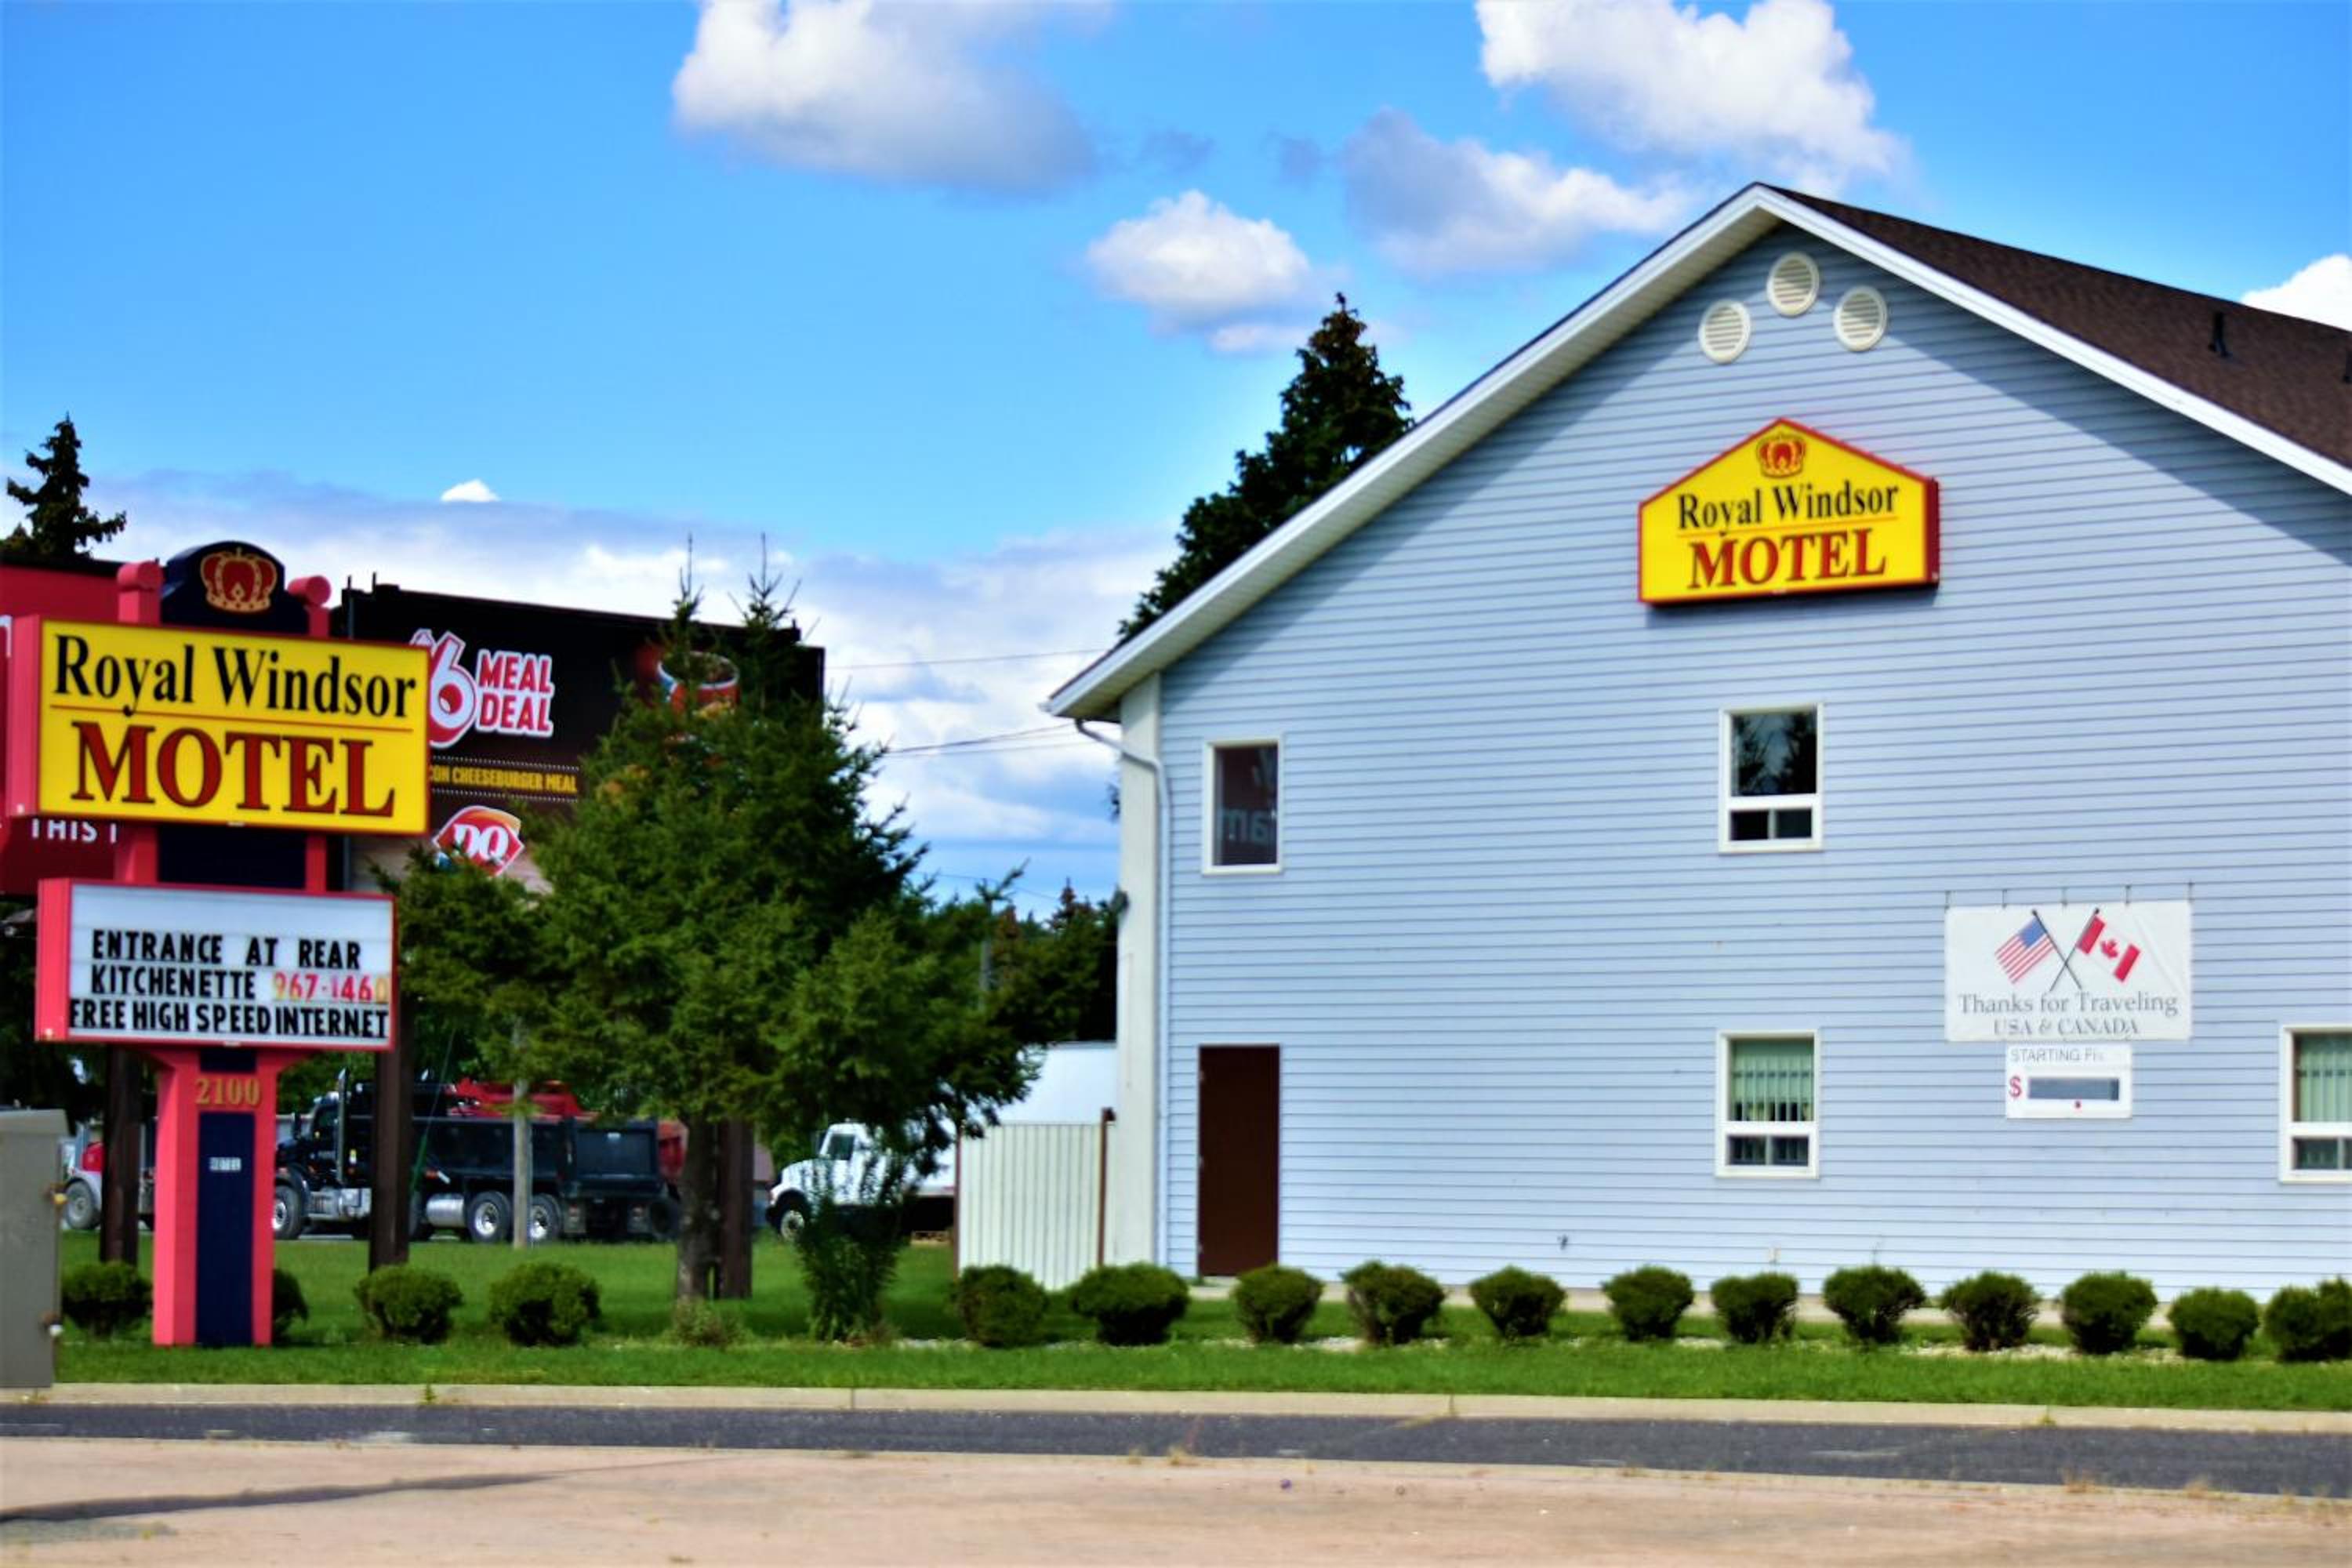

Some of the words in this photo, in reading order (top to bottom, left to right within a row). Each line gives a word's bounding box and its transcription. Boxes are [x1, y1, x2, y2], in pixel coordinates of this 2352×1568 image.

[1678, 488, 1762, 535] Royal
[1772, 479, 1900, 521] Windsor
[1688, 528, 1886, 590] MOTEL
[53, 634, 194, 717] Royal
[212, 647, 416, 718] Windsor
[409, 629, 477, 749] 6
[477, 650, 554, 695] MEAL
[477, 692, 554, 735] DEAL
[70, 720, 395, 818] MOTEL
[429, 764, 450, 784] ON
[452, 766, 543, 792] CHEESEBURGER
[546, 773, 578, 793] MEAL
[452, 823, 510, 862] DQ
[92, 929, 223, 964] ENTRANCE
[245, 938, 279, 967] AT
[299, 938, 361, 970] REAR
[91, 964, 256, 1000] KITCHENETTE
[69, 999, 126, 1029] FREE
[132, 1001, 190, 1033] HIGH
[195, 1003, 271, 1035] SPEED
[275, 1006, 389, 1039] INTERNET
[1958, 993, 2033, 1014] Thanks
[2041, 992, 2070, 1013] for
[2076, 991, 2179, 1017] Traveling
[1994, 1018, 2033, 1035] USA
[2038, 1018, 2053, 1035] &
[2057, 1018, 2140, 1036] CANADA
[2009, 1047, 2081, 1062] STARTING
[195, 1077, 260, 1105] 2100
[2009, 1075, 2023, 1098] $
